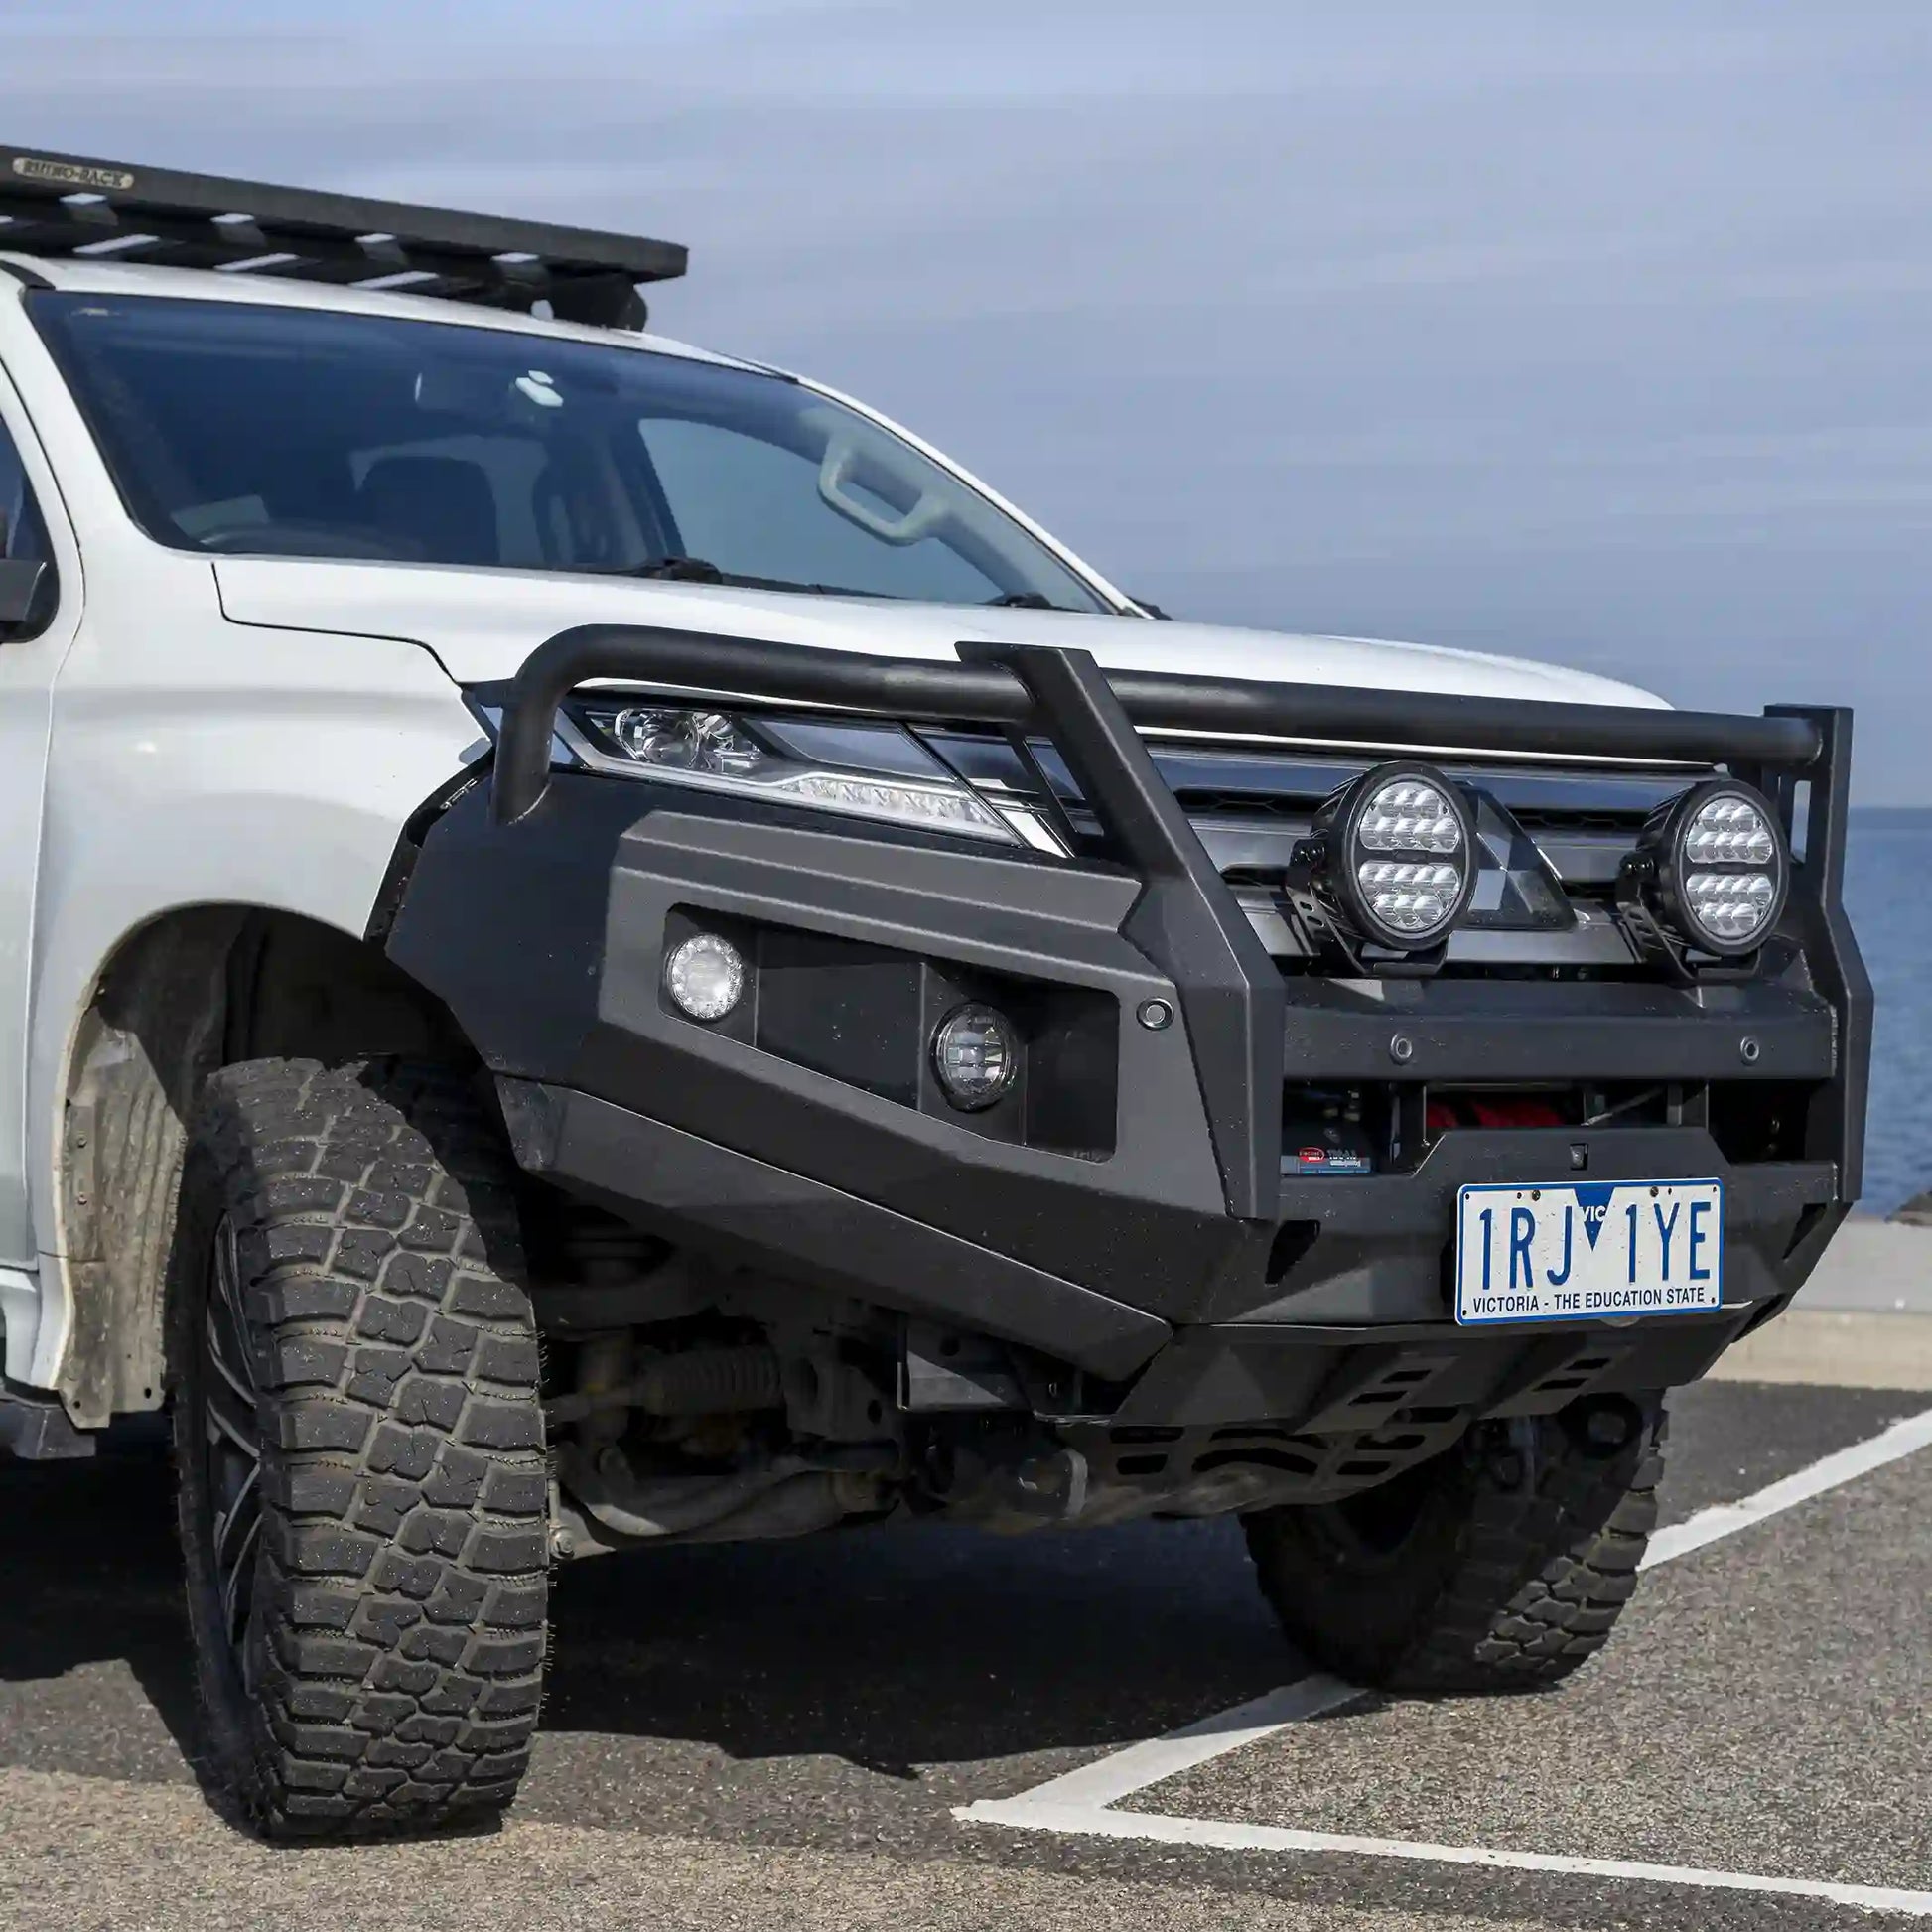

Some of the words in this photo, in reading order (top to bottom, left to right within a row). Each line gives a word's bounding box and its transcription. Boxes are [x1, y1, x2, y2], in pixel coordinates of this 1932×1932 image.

[1473, 1295, 1539, 1313] VICTORIA
[1554, 1293, 1580, 1310] THE
[1585, 1290, 1662, 1308] EDUCATION
[1666, 1287, 1705, 1304] STATE
